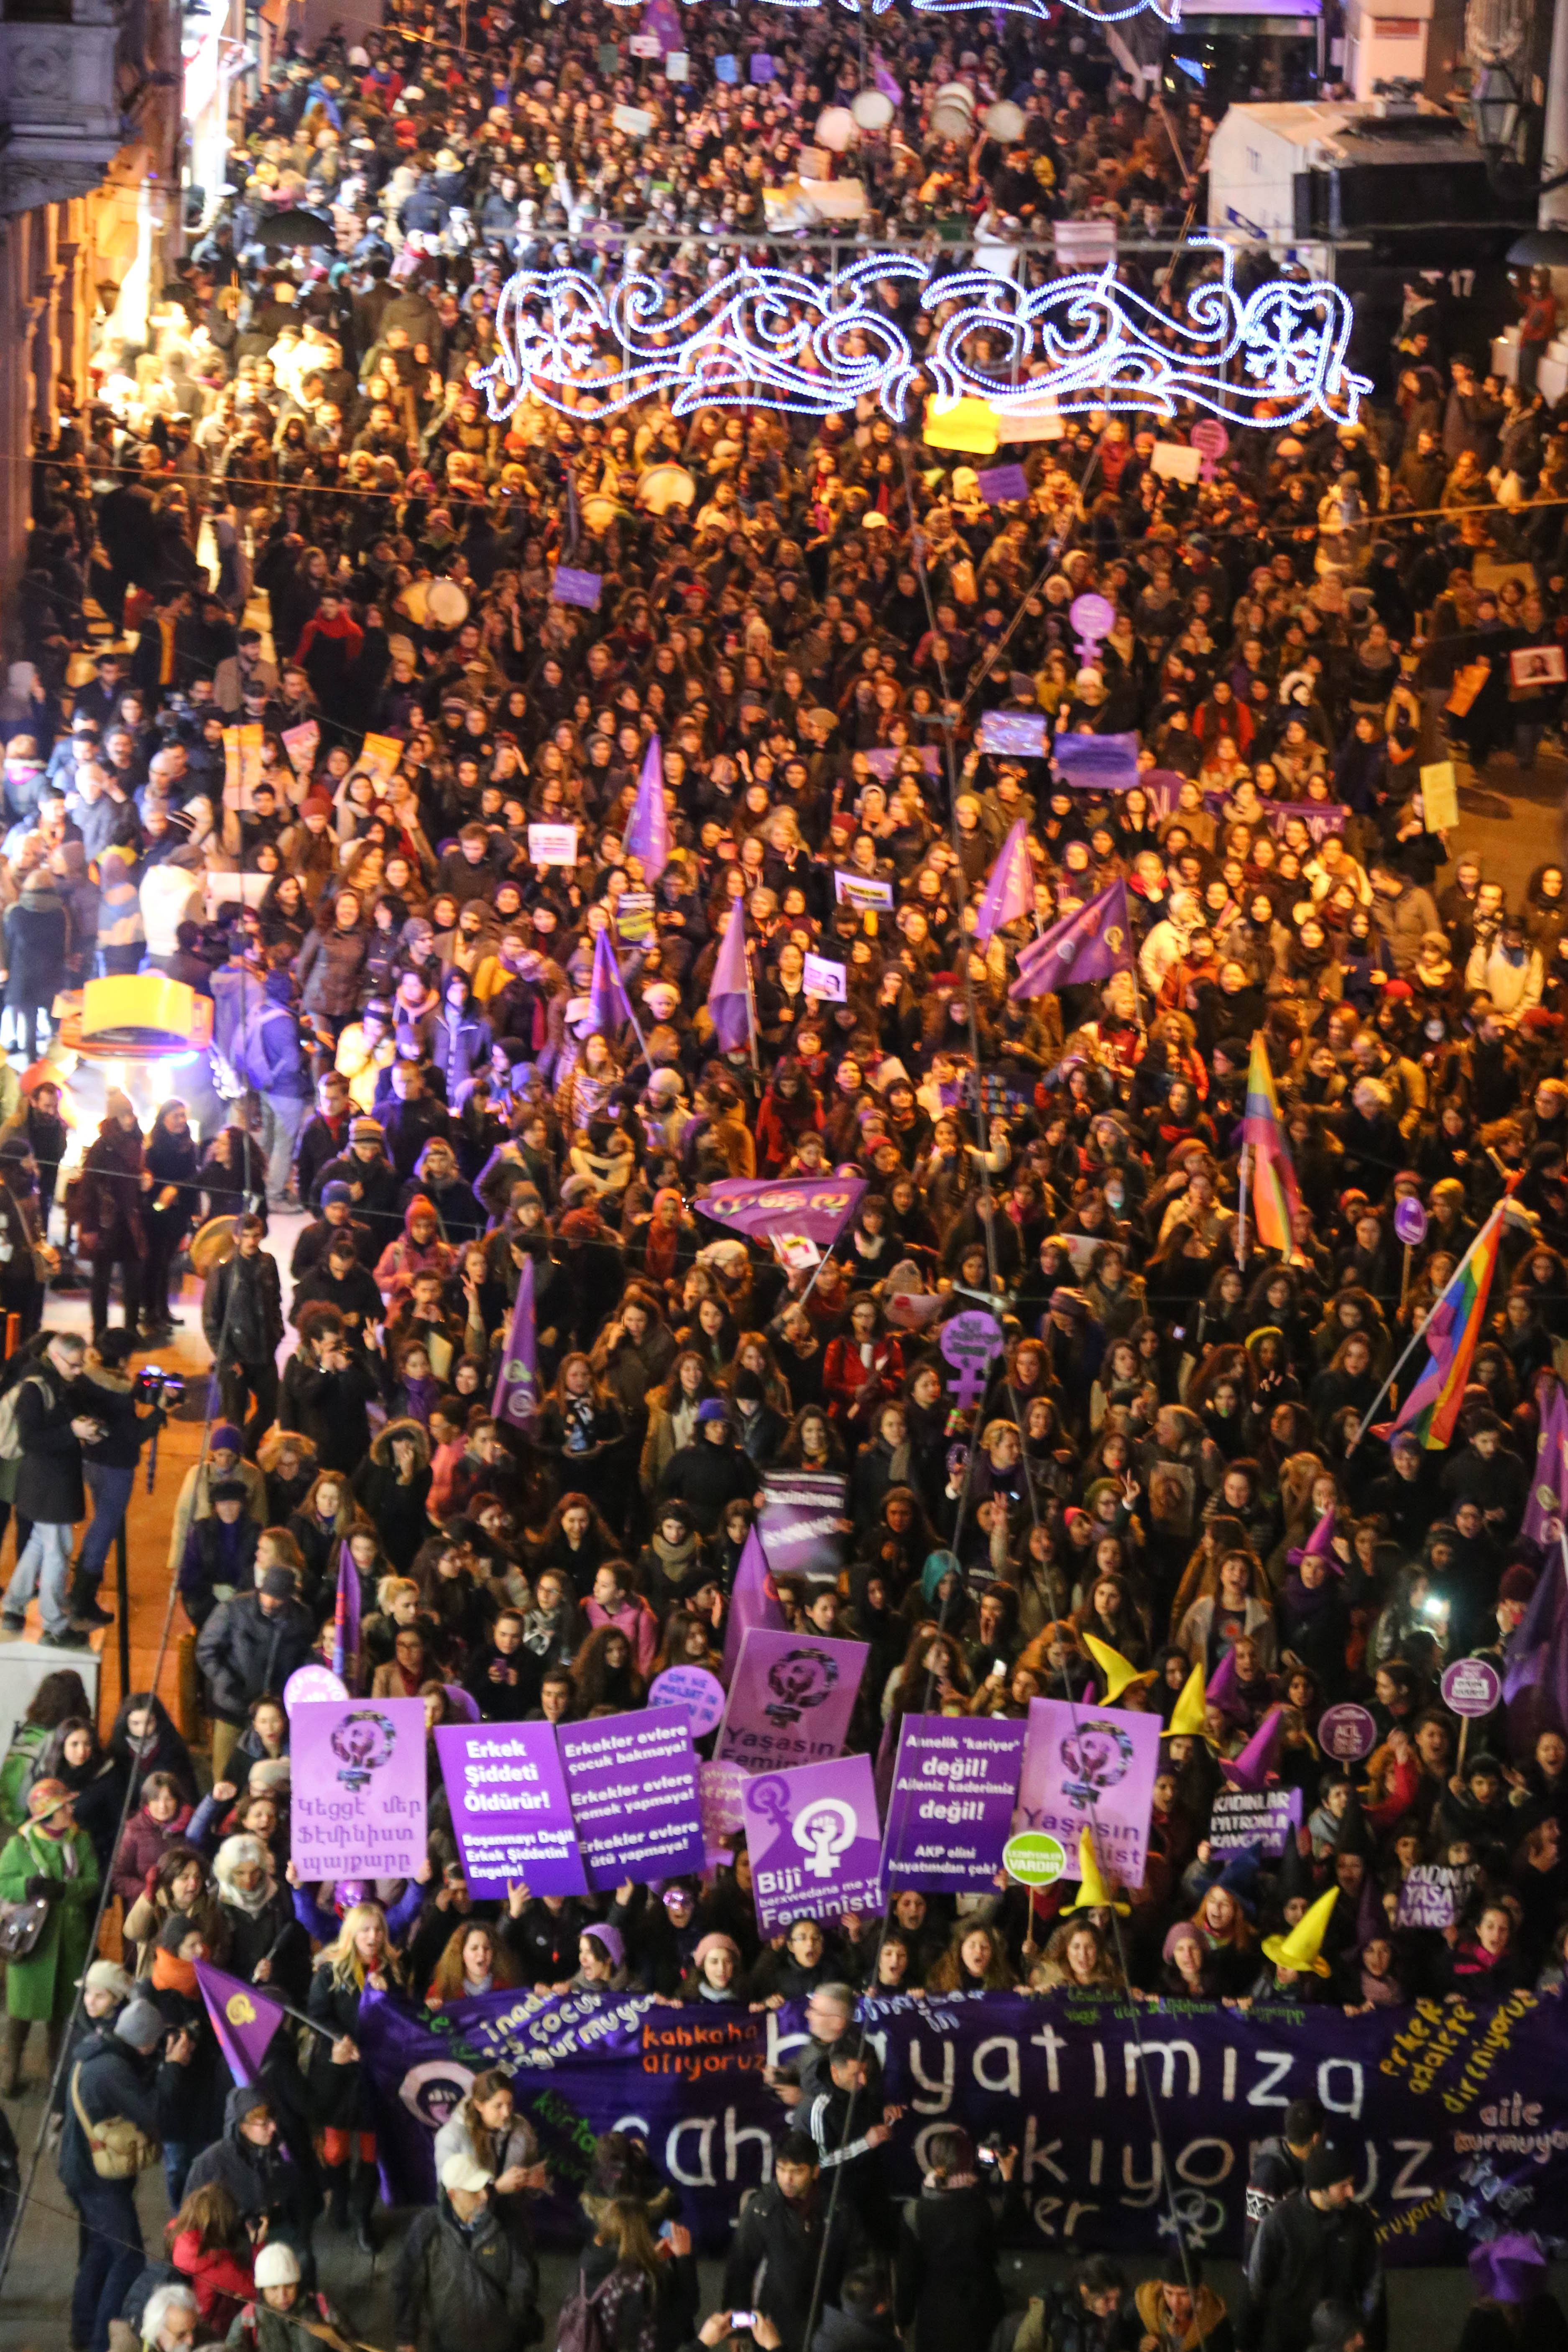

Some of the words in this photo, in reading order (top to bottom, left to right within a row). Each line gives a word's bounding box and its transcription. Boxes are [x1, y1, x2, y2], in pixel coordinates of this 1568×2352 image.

[465, 1738, 528, 1758] Erkek
[564, 1735, 634, 1758] Erkekler
[637, 1725, 688, 1744] evlere
[726, 1726, 835, 1756] Yaşasın
[905, 1734, 959, 1749] Annelik
[568, 1754, 613, 1776] çocuk
[616, 1739, 687, 1764] bakmaya!
[922, 1756, 988, 1781] değil!
[464, 1762, 539, 1788] Şiddeti
[463, 1789, 551, 1812] Öldürür!
[571, 1784, 640, 1806] Erkekler
[643, 1774, 693, 1793] evlere
[573, 1802, 622, 1823] yemek
[624, 1787, 695, 1814] yapmaya!
[919, 1799, 986, 1824] değil!
[537, 1828, 575, 1845] Değil
[649, 1821, 700, 1841] evlere
[465, 1849, 506, 1862] Erkek
[506, 1846, 569, 1864] Şiddetini
[618, 1837, 689, 1864] yapmaya!
[914, 1845, 945, 1858] AKP
[468, 1863, 525, 1880] Engelle!
[1009, 1859, 1060, 1874] VARDIR
[766, 2012, 1364, 2121] hyatımıza
[1479, 2091, 1543, 2127] aile
[1454, 2129, 1568, 2164] kurmuyo
